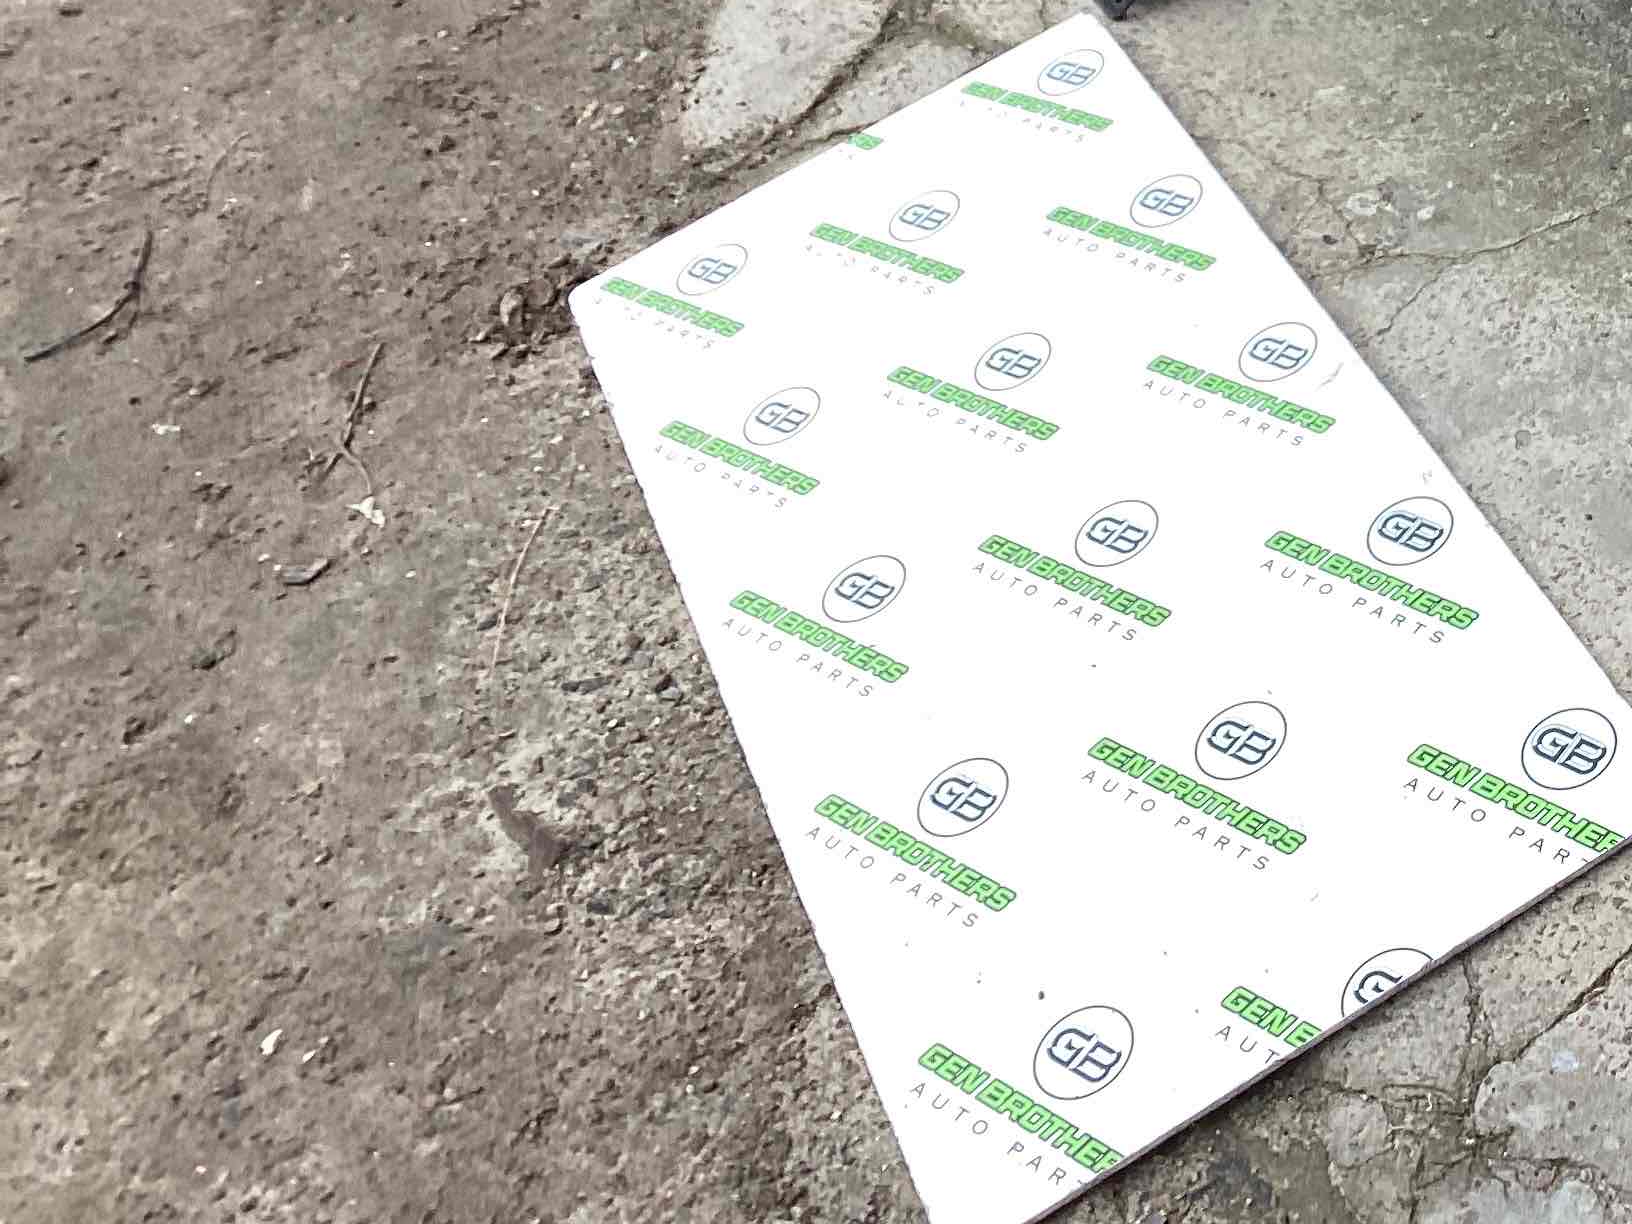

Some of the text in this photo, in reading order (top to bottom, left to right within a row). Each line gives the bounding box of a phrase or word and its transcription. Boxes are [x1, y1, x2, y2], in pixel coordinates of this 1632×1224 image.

[1046, 61, 1096, 86] GB
[960, 81, 1008, 101] GEN
[999, 91, 1114, 132] BROTHERS
[899, 204, 951, 230] GB
[1139, 189, 1194, 217] GB
[809, 223, 965, 284] GEN BROTHERS
[1046, 206, 1217, 271] GEN BROTHERS
[1115, 252, 1186, 283] PARTS
[688, 258, 737, 284] GB
[600, 277, 648, 300] GEN
[636, 290, 745, 338] BROTHERS
[985, 347, 1042, 379] GB
[1249, 338, 1309, 370] GB
[755, 402, 810, 433] GB
[886, 366, 1060, 440] GEN BROTHERS
[1143, 380, 1304, 446] AUTO PARTS
[1146, 355, 1336, 434] GEN BROTHERS
[659, 420, 820, 495] GEN BROTHERS
[1086, 517, 1149, 553] GB
[1377, 512, 1444, 552] GB
[835, 572, 895, 609] GB
[972, 562, 1137, 641] AUTO PARTS
[977, 534, 1172, 627] GEN BROTHERS
[1260, 559, 1445, 644] AUTO PARTS
[1264, 530, 1480, 630] GEN BROTHERS
[722, 618, 873, 696] AUTO PARTS
[729, 590, 909, 683] GEN BROTHERS
[1206, 720, 1276, 765] GB
[1407, 743, 1481, 788] GEN
[1532, 725, 1607, 775] GB
[930, 776, 997, 822] GB
[1081, 770, 1270, 870] AUTO PARTS
[1088, 737, 1307, 855] GEN BROTHERS
[1403, 777, 1590, 864] AUTO PAR
[805, 826, 978, 927] AUTO PARTS
[814, 793, 1017, 912] GEN BROTHERS
[1221, 986, 1298, 1038] GEN
[918, 1042, 991, 1095] GEN
[1047, 1027, 1122, 1083] GB
[910, 1082, 1088, 1185] AUTO PAR
